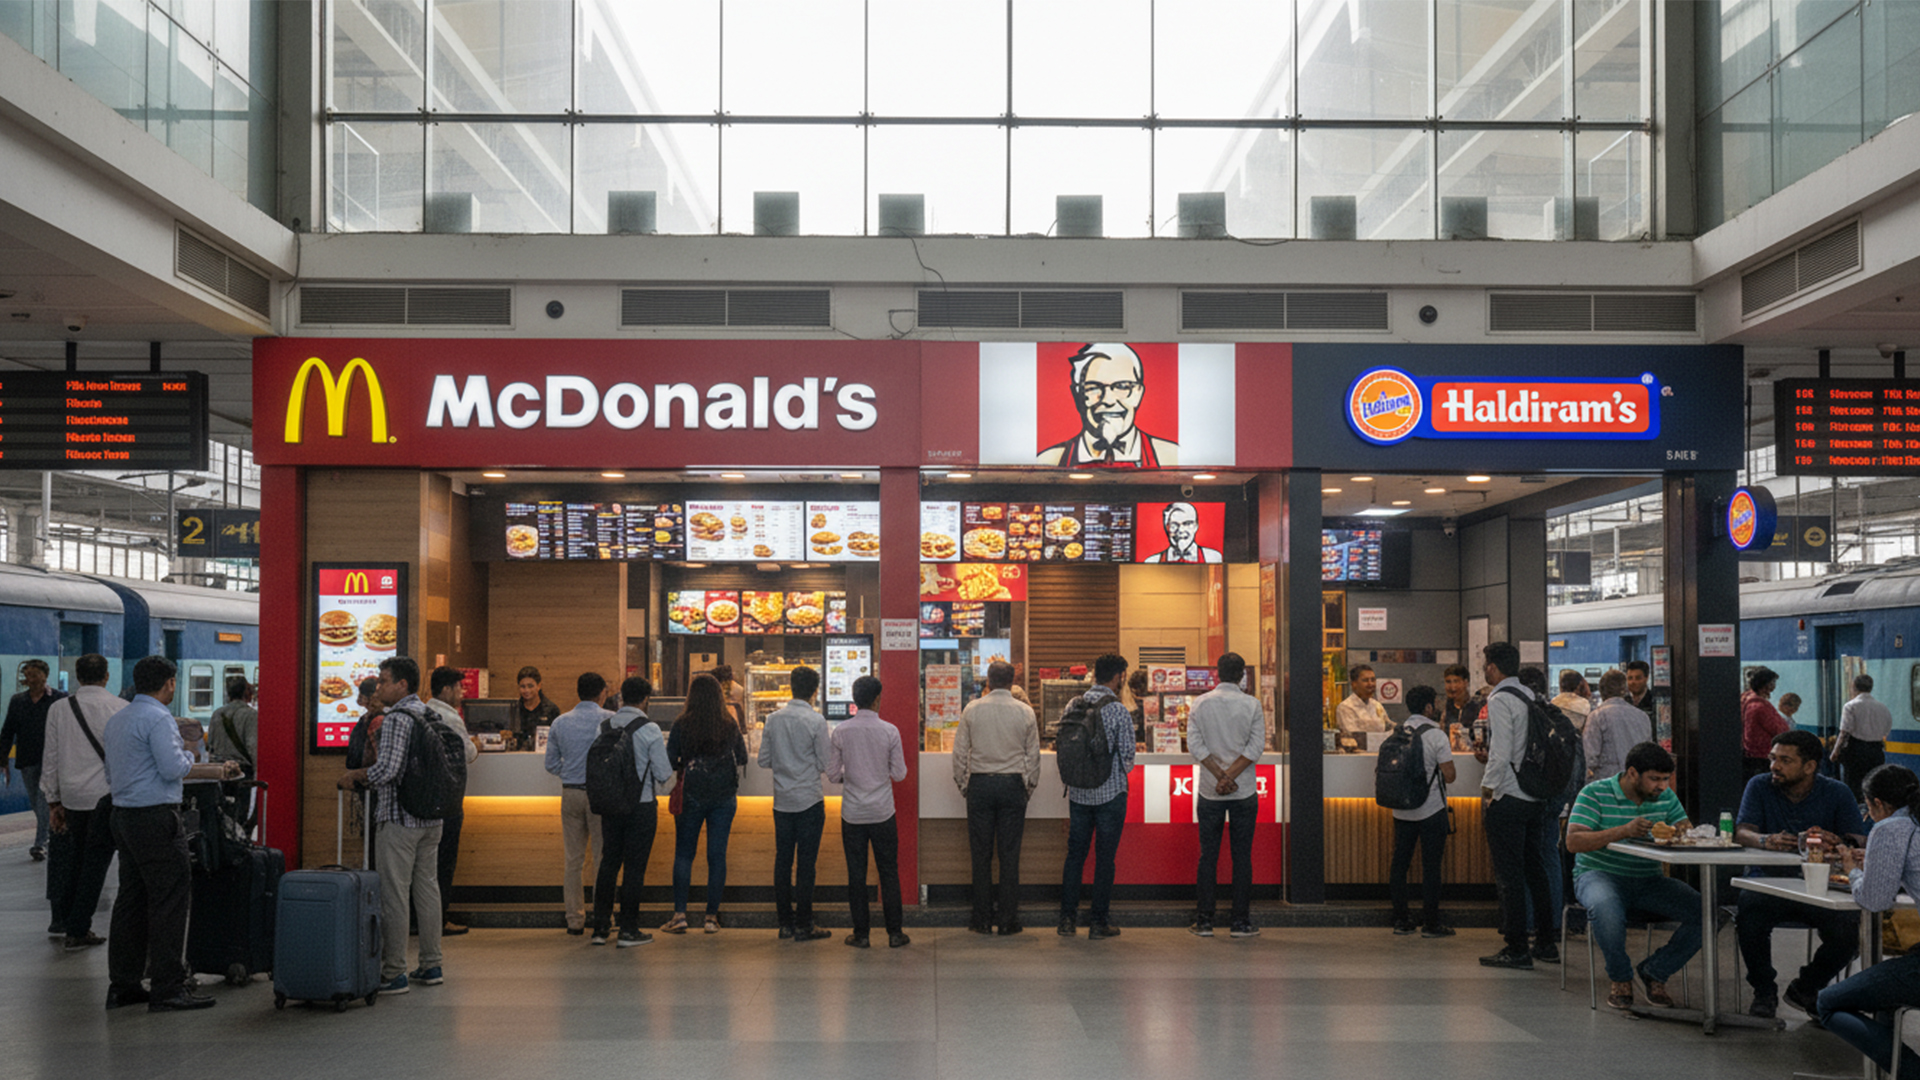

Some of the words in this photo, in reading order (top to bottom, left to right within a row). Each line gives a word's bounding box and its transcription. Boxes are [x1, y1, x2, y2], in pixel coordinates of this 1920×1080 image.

[426, 374, 878, 430] McDonald's
[1441, 389, 1638, 423] Haldiram's
[182, 516, 206, 544] 2
